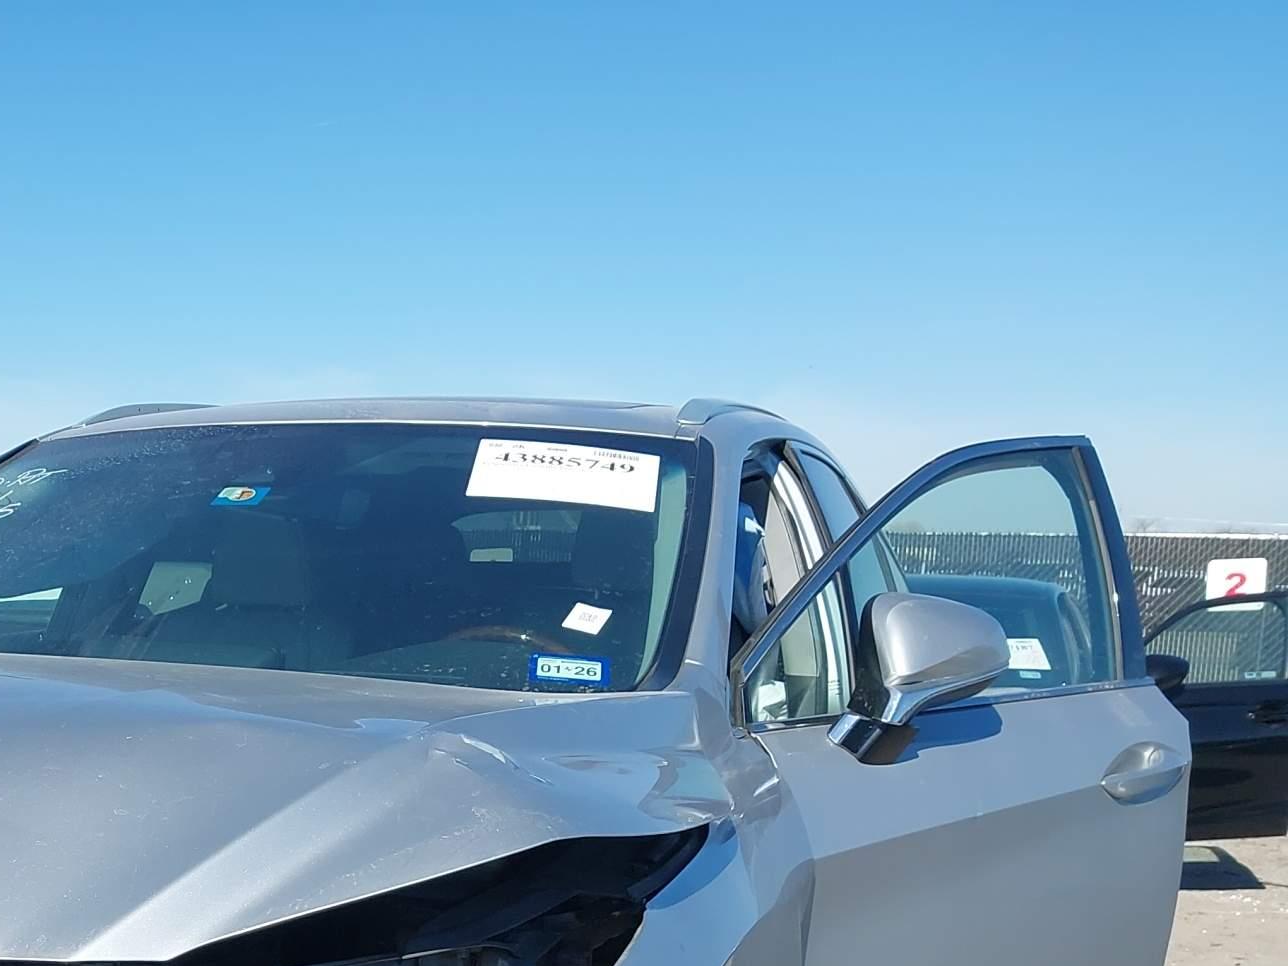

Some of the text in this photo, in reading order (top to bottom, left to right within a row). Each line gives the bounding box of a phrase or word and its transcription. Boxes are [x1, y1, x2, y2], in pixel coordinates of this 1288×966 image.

[496, 451, 635, 473] 43885749
[1225, 573, 1247, 599] 2
[574, 666, 597, 677] 26
